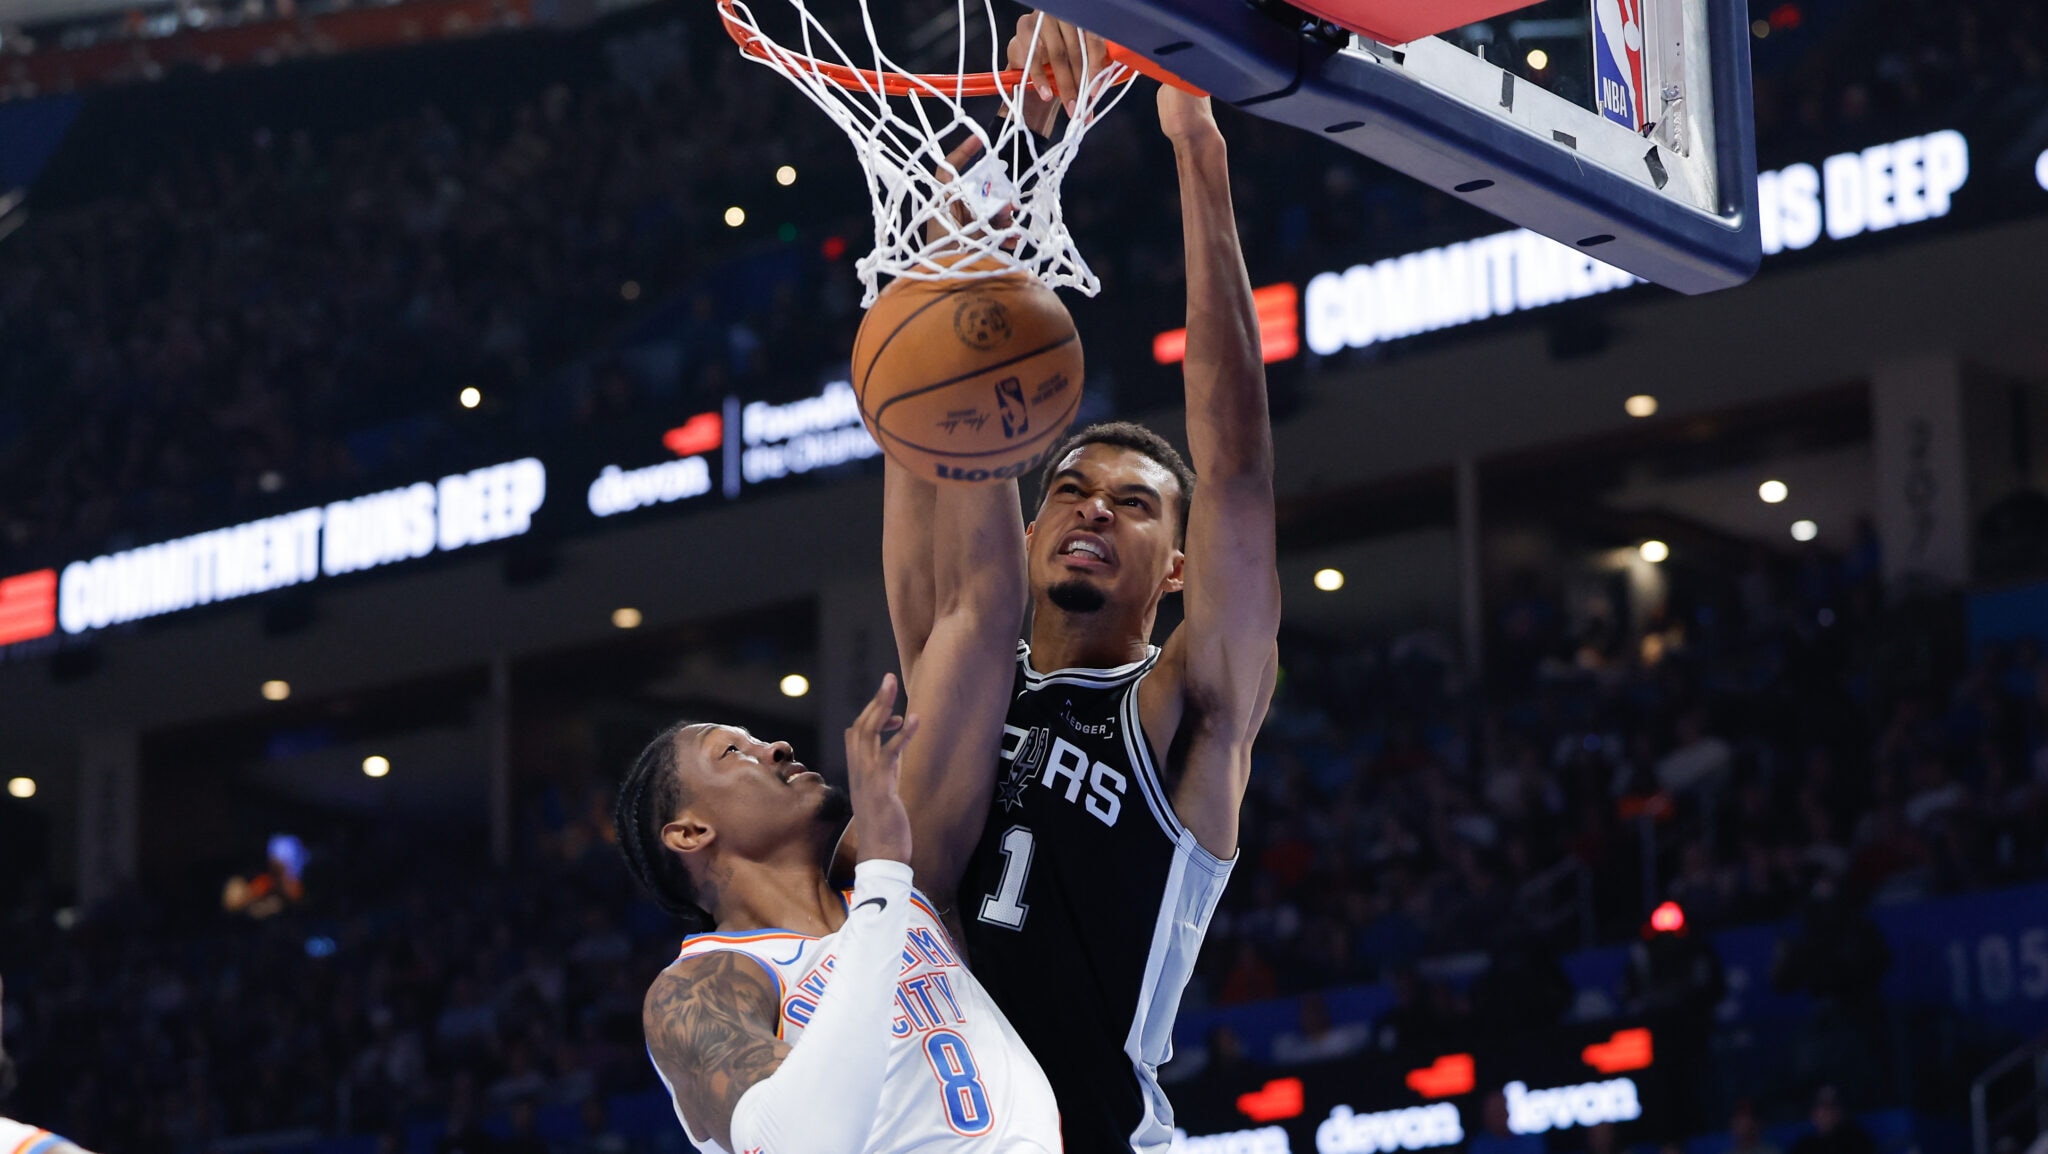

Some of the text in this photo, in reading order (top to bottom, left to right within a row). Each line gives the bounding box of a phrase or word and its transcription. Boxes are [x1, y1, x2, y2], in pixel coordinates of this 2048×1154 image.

[1602, 76, 1628, 118] NBA
[1306, 228, 1648, 354] COMMITME
[1824, 130, 1968, 240] DEEP
[588, 457, 710, 516] devon
[60, 457, 545, 634] COMMITMENT RUNS DEEP
[1065, 709, 1107, 735] LEDGER
[977, 824, 1034, 932] 1
[922, 1028, 994, 1137] 8
[1316, 1102, 1463, 1154] devon
